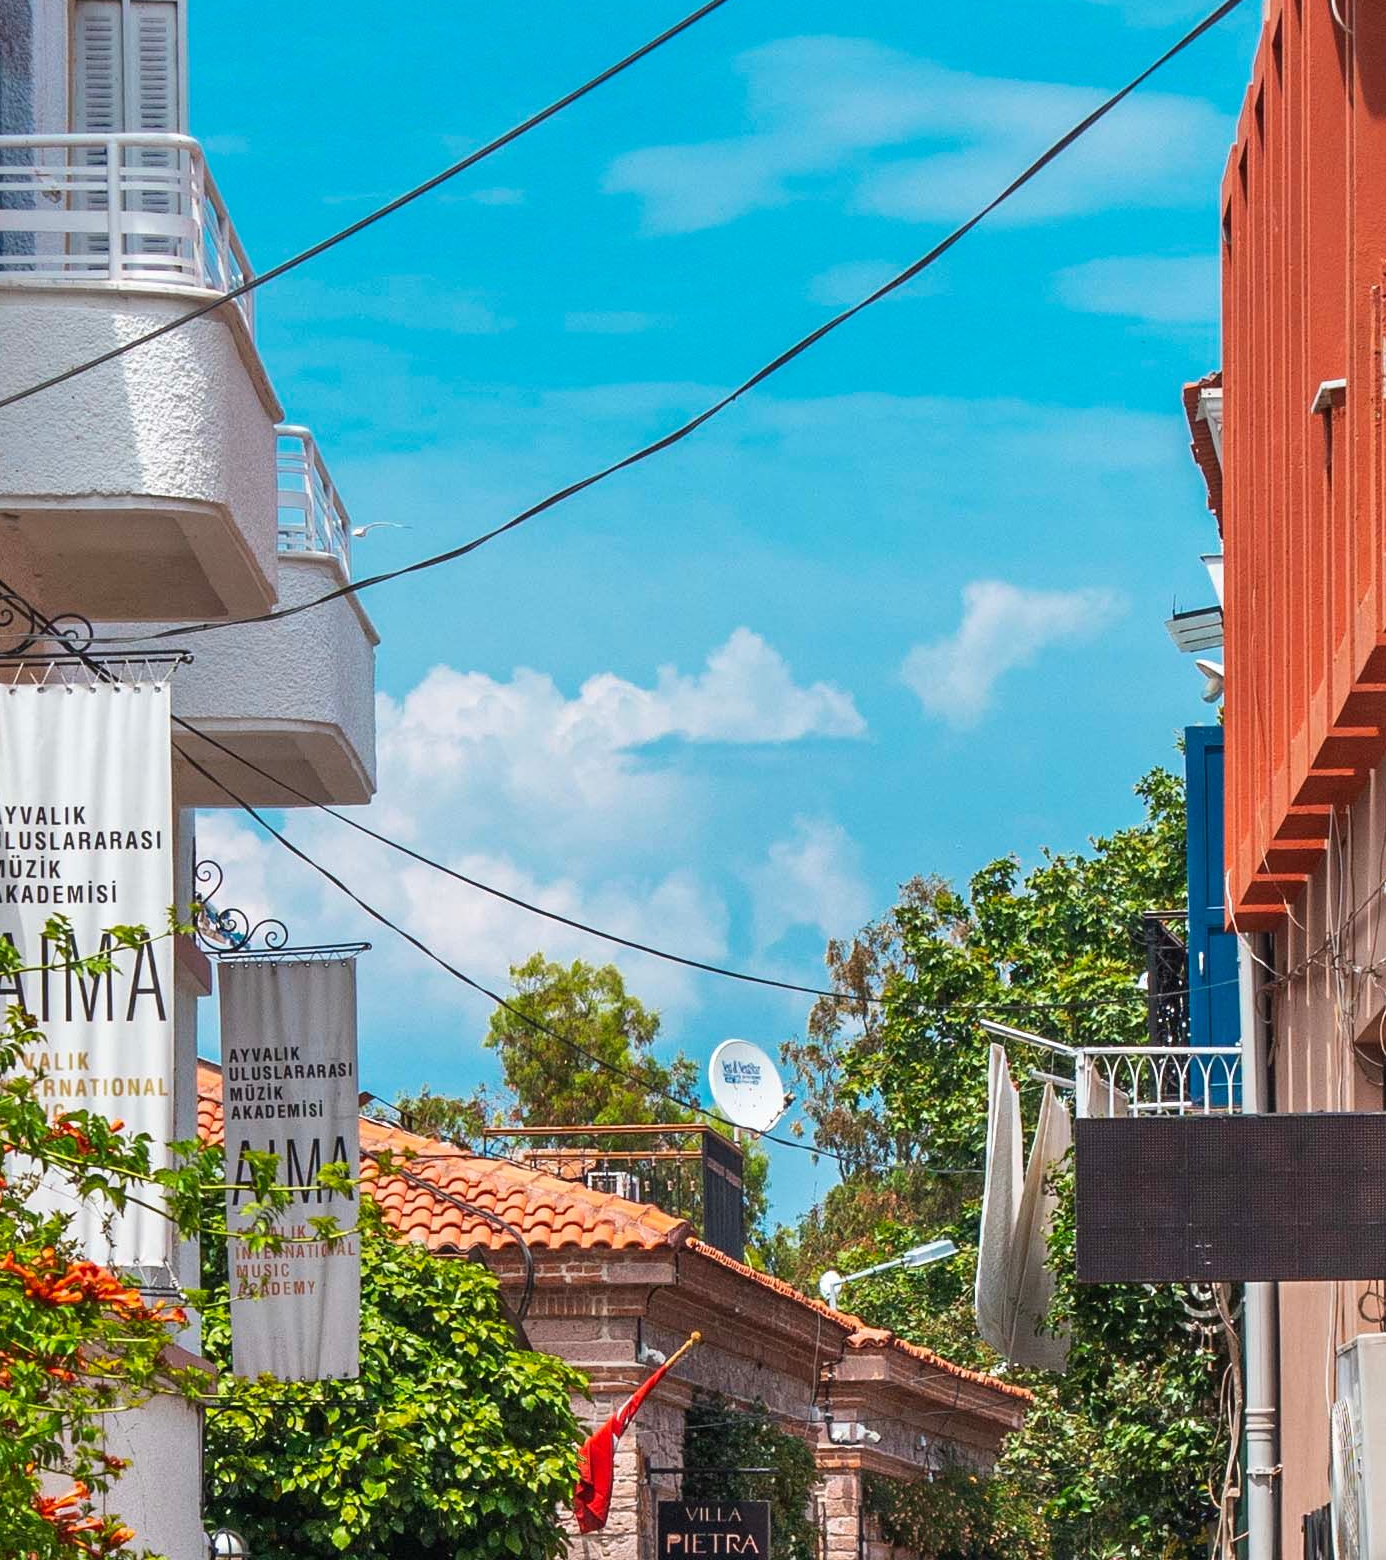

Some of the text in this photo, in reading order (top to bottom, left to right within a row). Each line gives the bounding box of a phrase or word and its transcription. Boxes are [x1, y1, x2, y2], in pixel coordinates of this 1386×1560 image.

[9, 1052, 89, 1071] VALIK
[229, 1046, 300, 1063] AYVALIK
[229, 1062, 353, 1082] ULUSLARARASI
[230, 1083, 283, 1102] MÜZİK
[231, 1099, 324, 1120] AKADEMİSİ
[236, 1263, 289, 1278] MUSIC
[686, 1507, 741, 1521] VILLA
[666, 1533, 759, 1554] PIETRA
